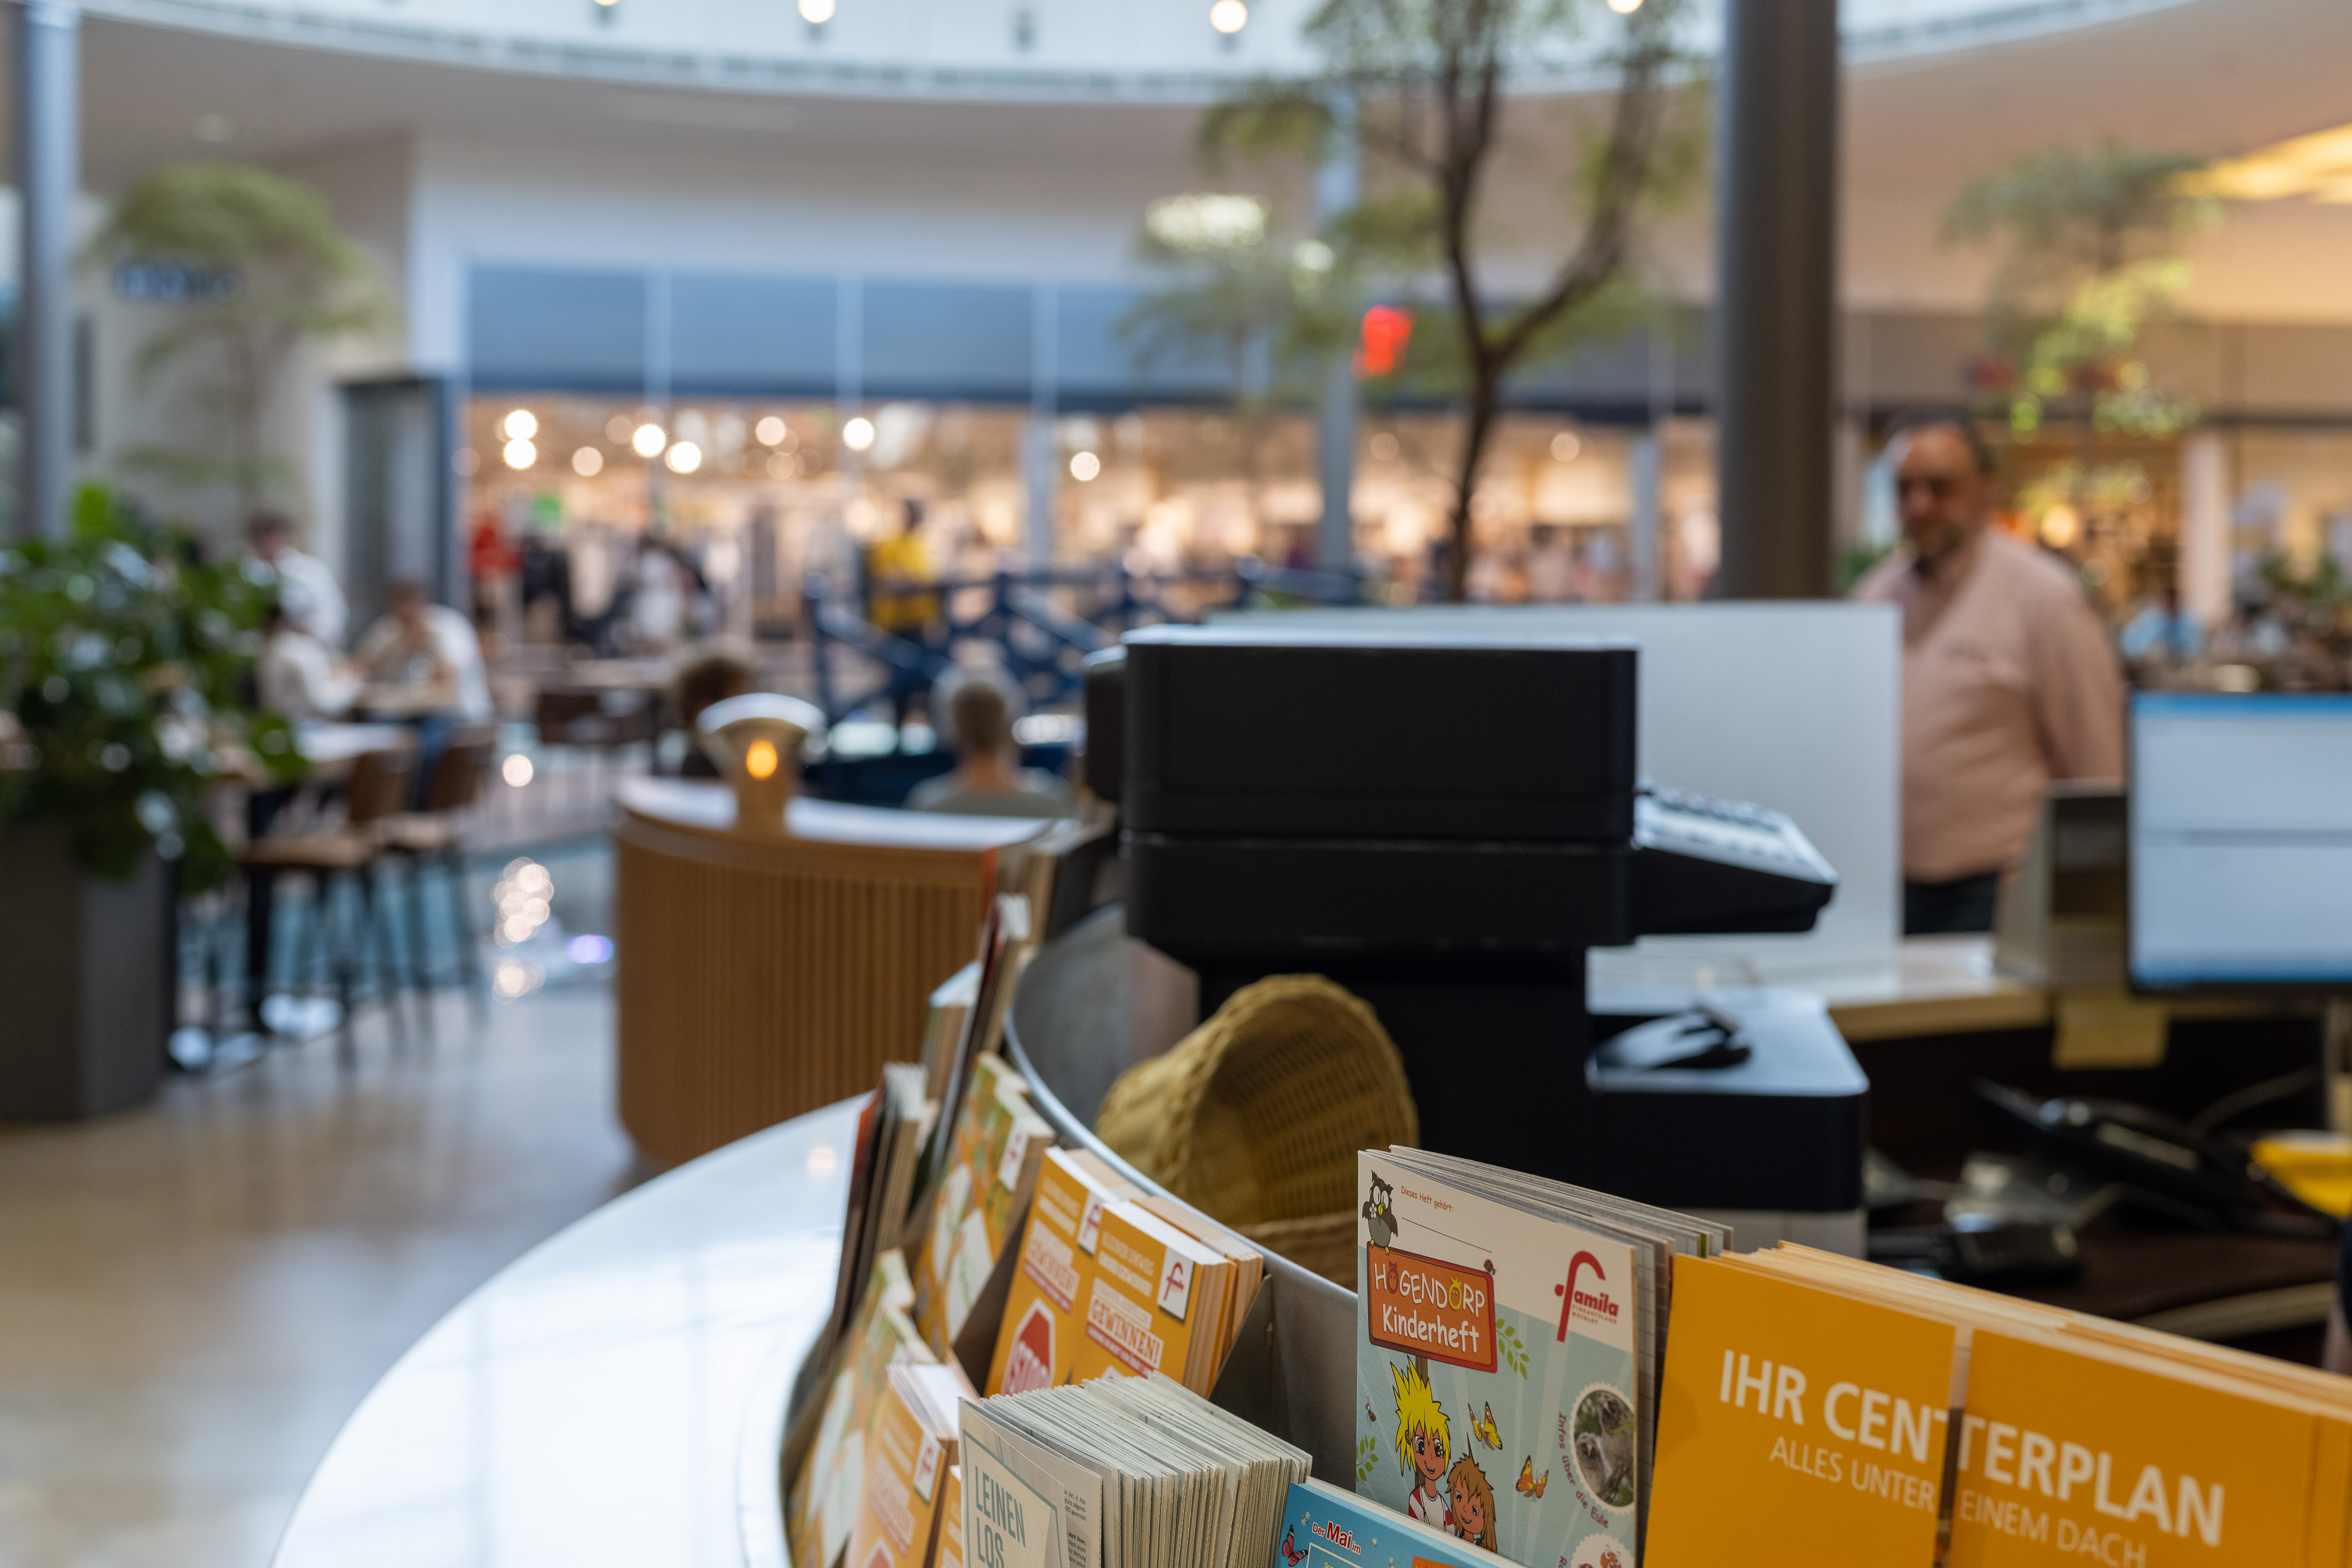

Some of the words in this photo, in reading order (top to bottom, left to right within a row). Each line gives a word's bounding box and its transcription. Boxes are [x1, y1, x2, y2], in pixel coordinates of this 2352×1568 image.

[1401, 1185, 1417, 1199] Dieses
[1419, 1192, 1432, 1204] Heft
[1434, 1200, 1454, 1212] gehört:
[1382, 1303, 1480, 1353] Kinderheft
[1554, 1250, 1618, 1343] famila
[1719, 1349, 1807, 1426] IHR
[975, 1465, 1026, 1548] LEINEN
[1562, 1455, 1576, 1486] über
[1576, 1490, 1589, 1510] die
[1590, 1506, 1609, 1528] Eule
[1768, 1435, 1843, 1483] ALLES
[1851, 1459, 1936, 1514] UNTER
[1960, 1489, 2050, 1544] EINEM
[2056, 1517, 2148, 1568] DACH
[977, 1516, 1005, 1568] LOS
[1312, 1522, 1326, 1537] Der
[1326, 1520, 1353, 1550] Mai
[1352, 1540, 1362, 1555] im
